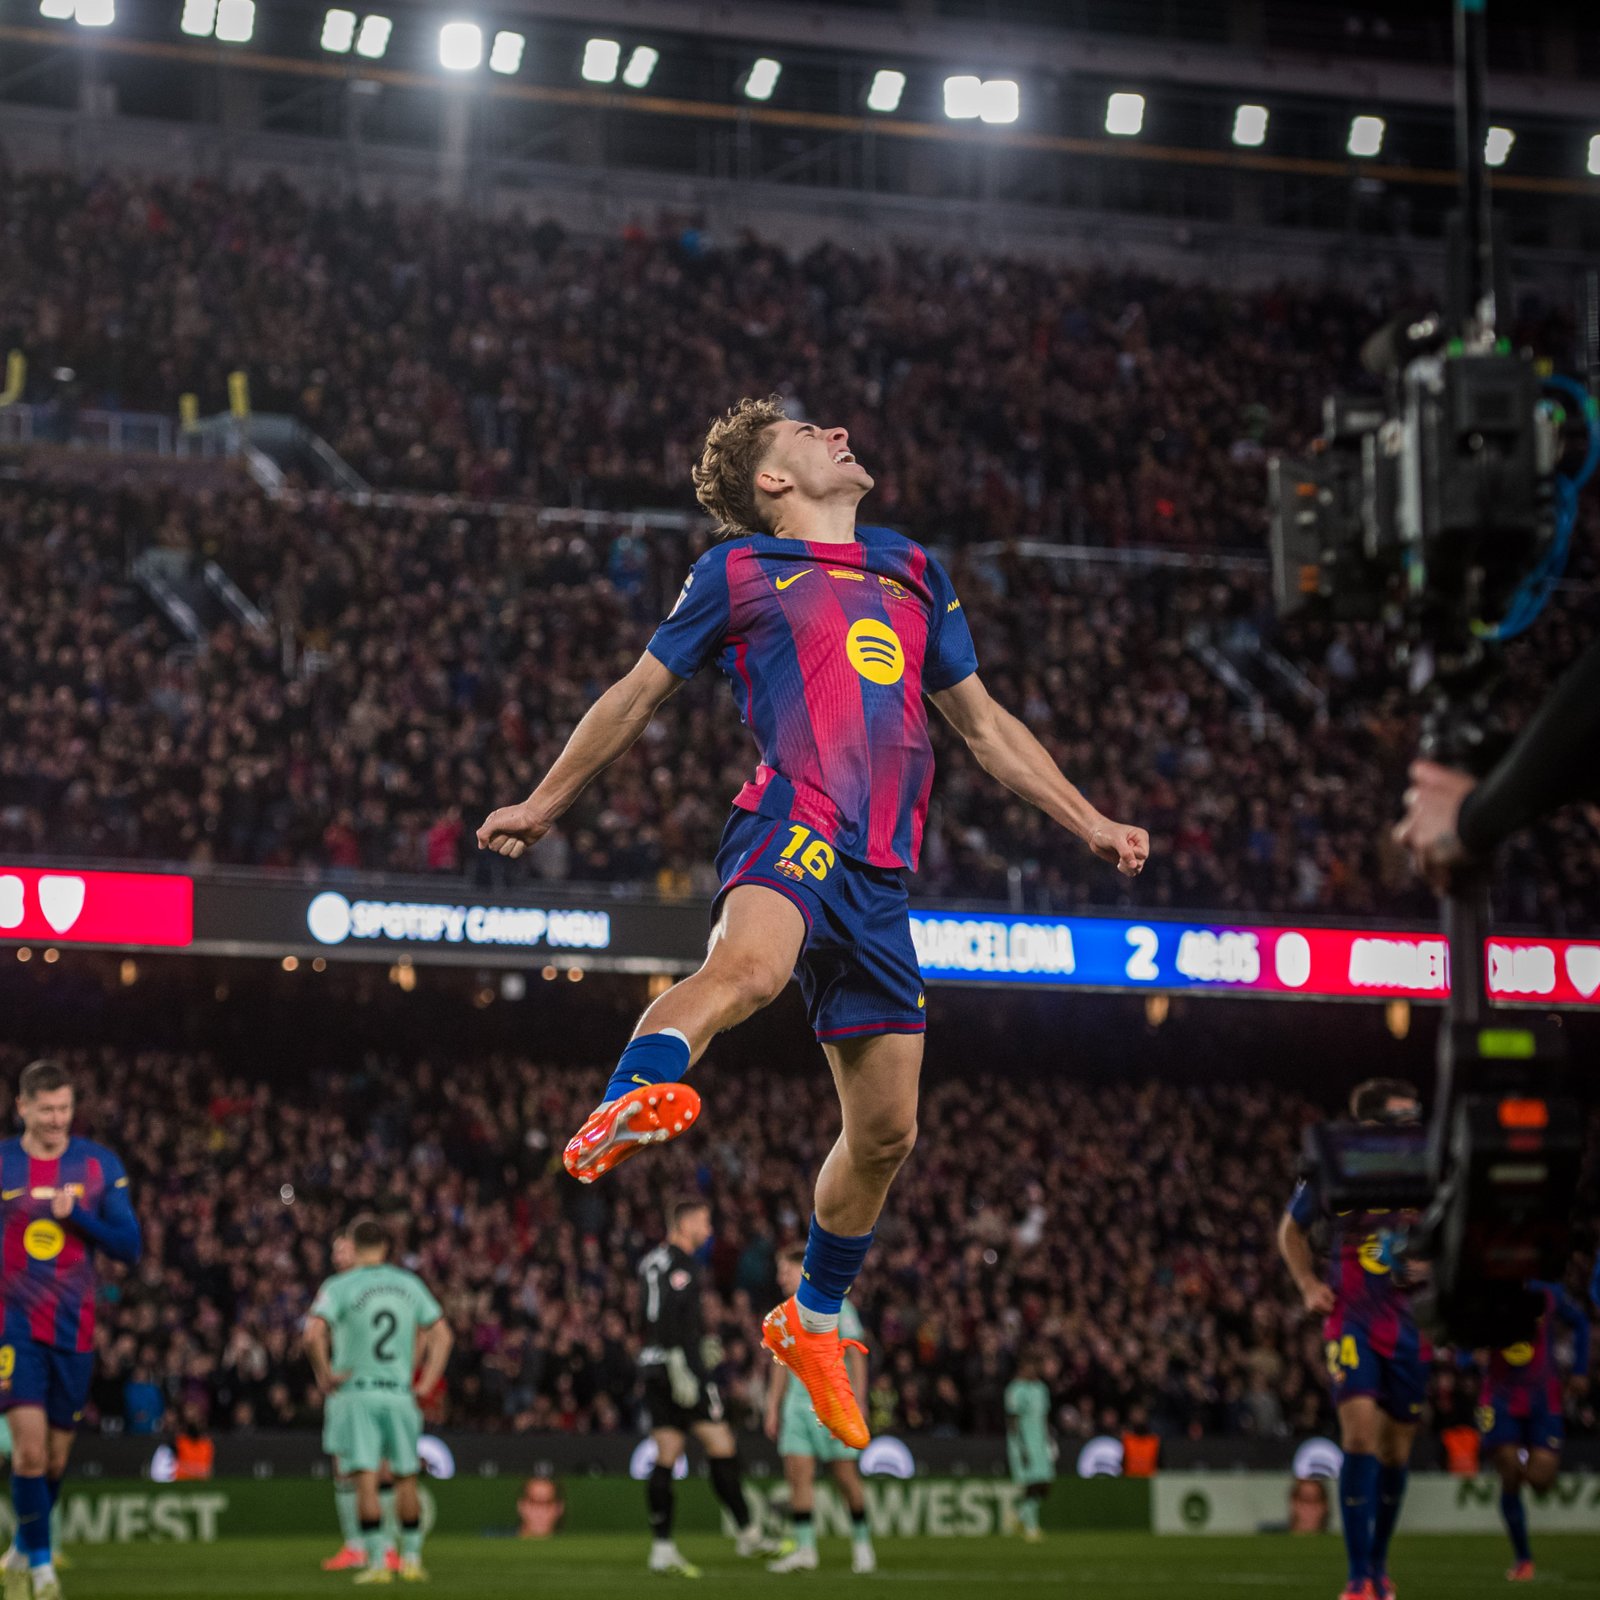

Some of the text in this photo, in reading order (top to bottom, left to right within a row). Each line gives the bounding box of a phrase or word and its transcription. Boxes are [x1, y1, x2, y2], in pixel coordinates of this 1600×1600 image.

[780, 824, 835, 881] 16
[350, 899, 611, 949] SPOTIFY CAMP NOU
[908, 917, 1076, 975] ARCELONA
[1125, 925, 1159, 981] 2
[1274, 931, 1311, 988] 0
[372, 1308, 399, 1364] 2
